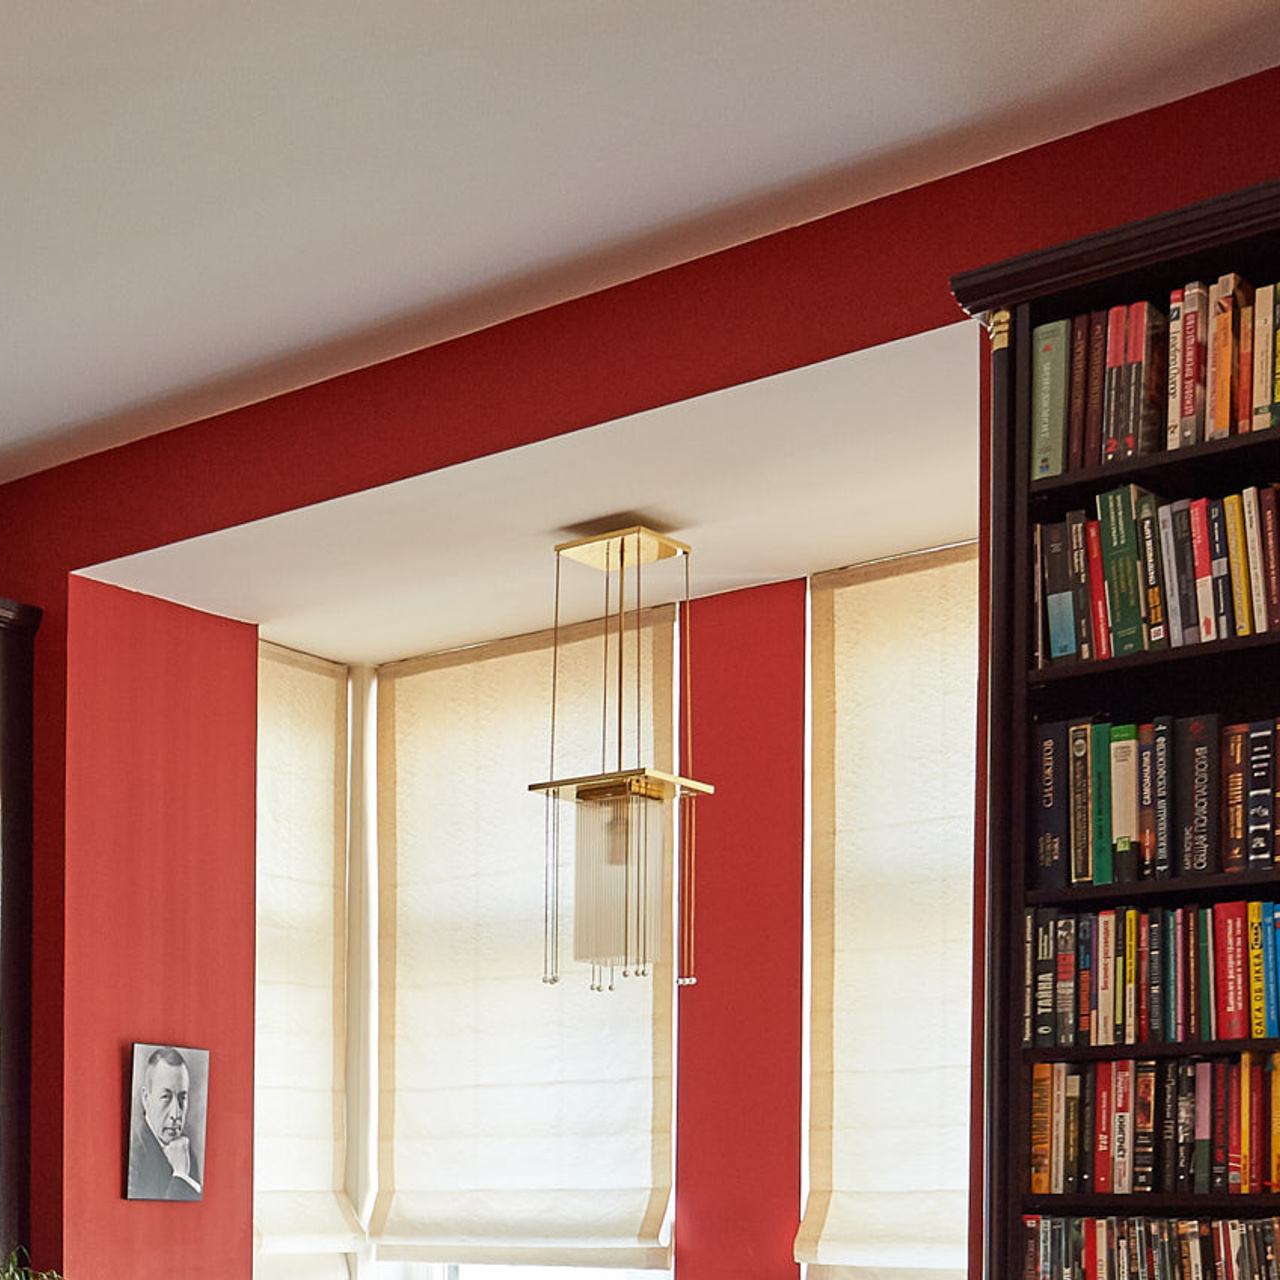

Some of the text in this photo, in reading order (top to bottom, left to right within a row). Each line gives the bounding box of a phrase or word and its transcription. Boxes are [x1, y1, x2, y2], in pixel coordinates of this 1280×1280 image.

[1184, 313, 1197, 415] ЦЕНОВОЕ ПРЕИМУЩЕСТВО
[1040, 361, 1052, 439] МЕНЕДЖМЕНТ
[1106, 439, 1118, 453] 2
[1124, 435, 1135, 449] 1
[1142, 751, 1152, 805] САМОАНАЛИЗ
[1195, 746, 1208, 870] ОБЩАЯ ПСИХОПАТОЛОГИЯ
[1035, 972, 1053, 1015] ТАЙНА
[1252, 953, 1264, 1035] САГА ОБ ИКЕА
